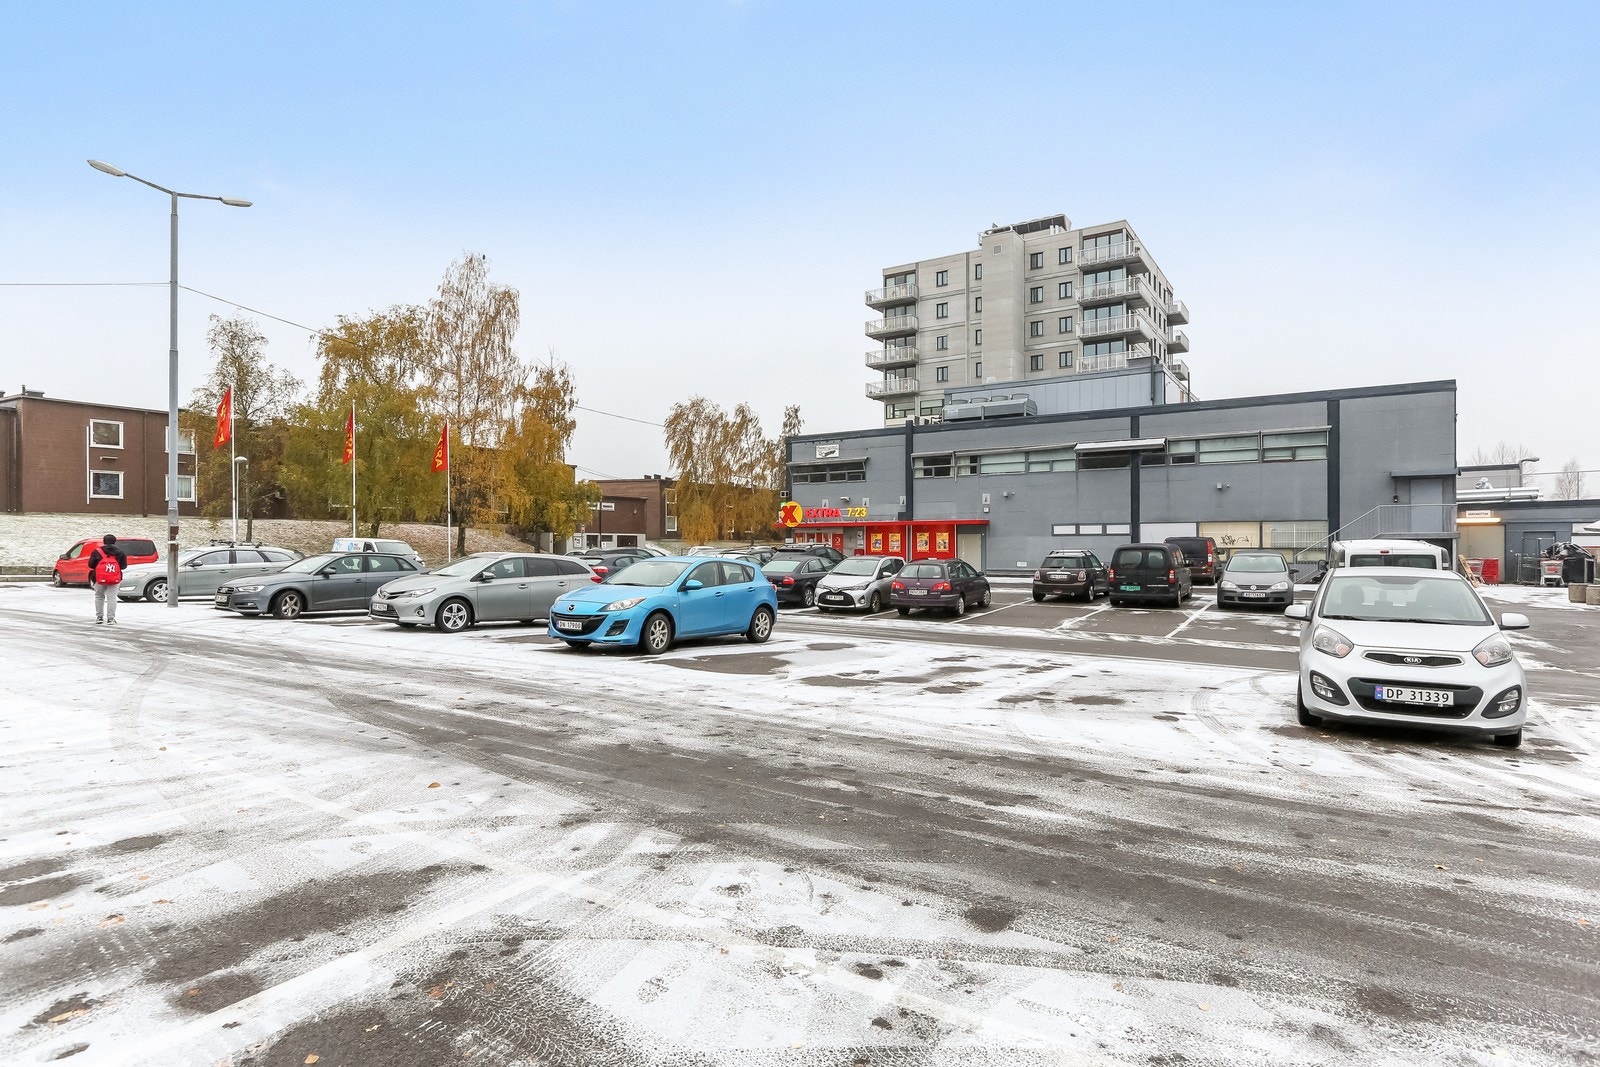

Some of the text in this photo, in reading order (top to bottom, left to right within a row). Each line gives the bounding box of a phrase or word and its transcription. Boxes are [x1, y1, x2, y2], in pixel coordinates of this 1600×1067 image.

[805, 507, 841, 518] EXTRA
[847, 507, 867, 517] 7-23
[105, 563, 116, 573] NY
[1386, 688, 1449, 703] DP 31339
